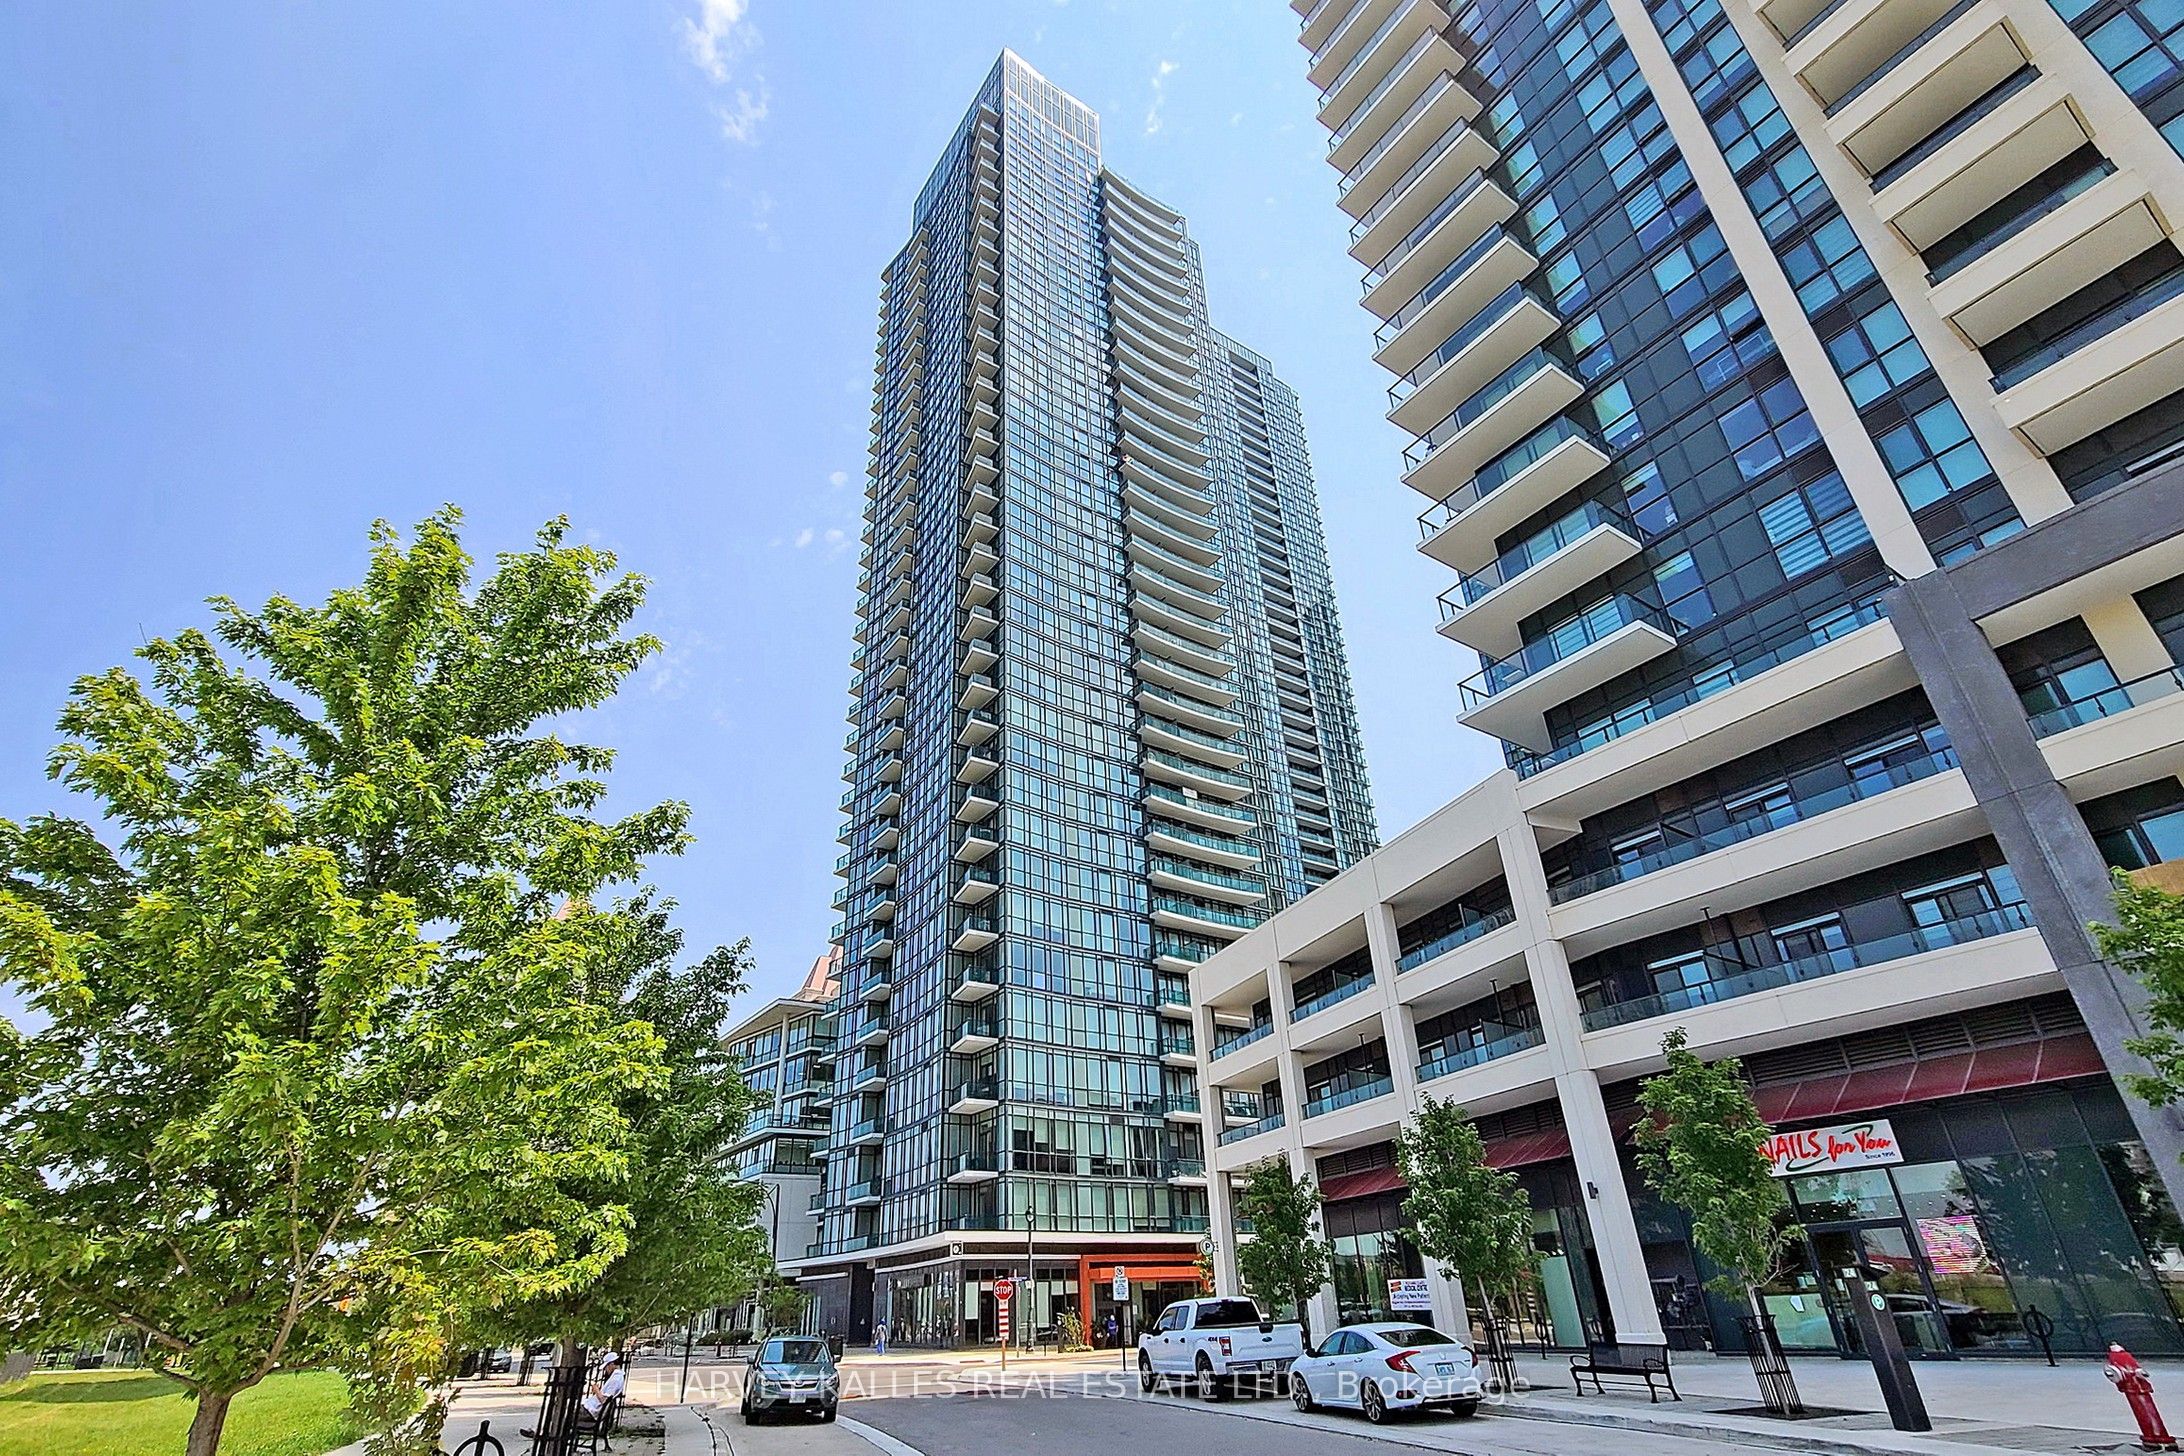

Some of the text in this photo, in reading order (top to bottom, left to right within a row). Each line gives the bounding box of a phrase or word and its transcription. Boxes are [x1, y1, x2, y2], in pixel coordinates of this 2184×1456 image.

[1758, 1131, 1891, 1168] NAILS for You
[996, 1286, 1012, 1295] STOP
